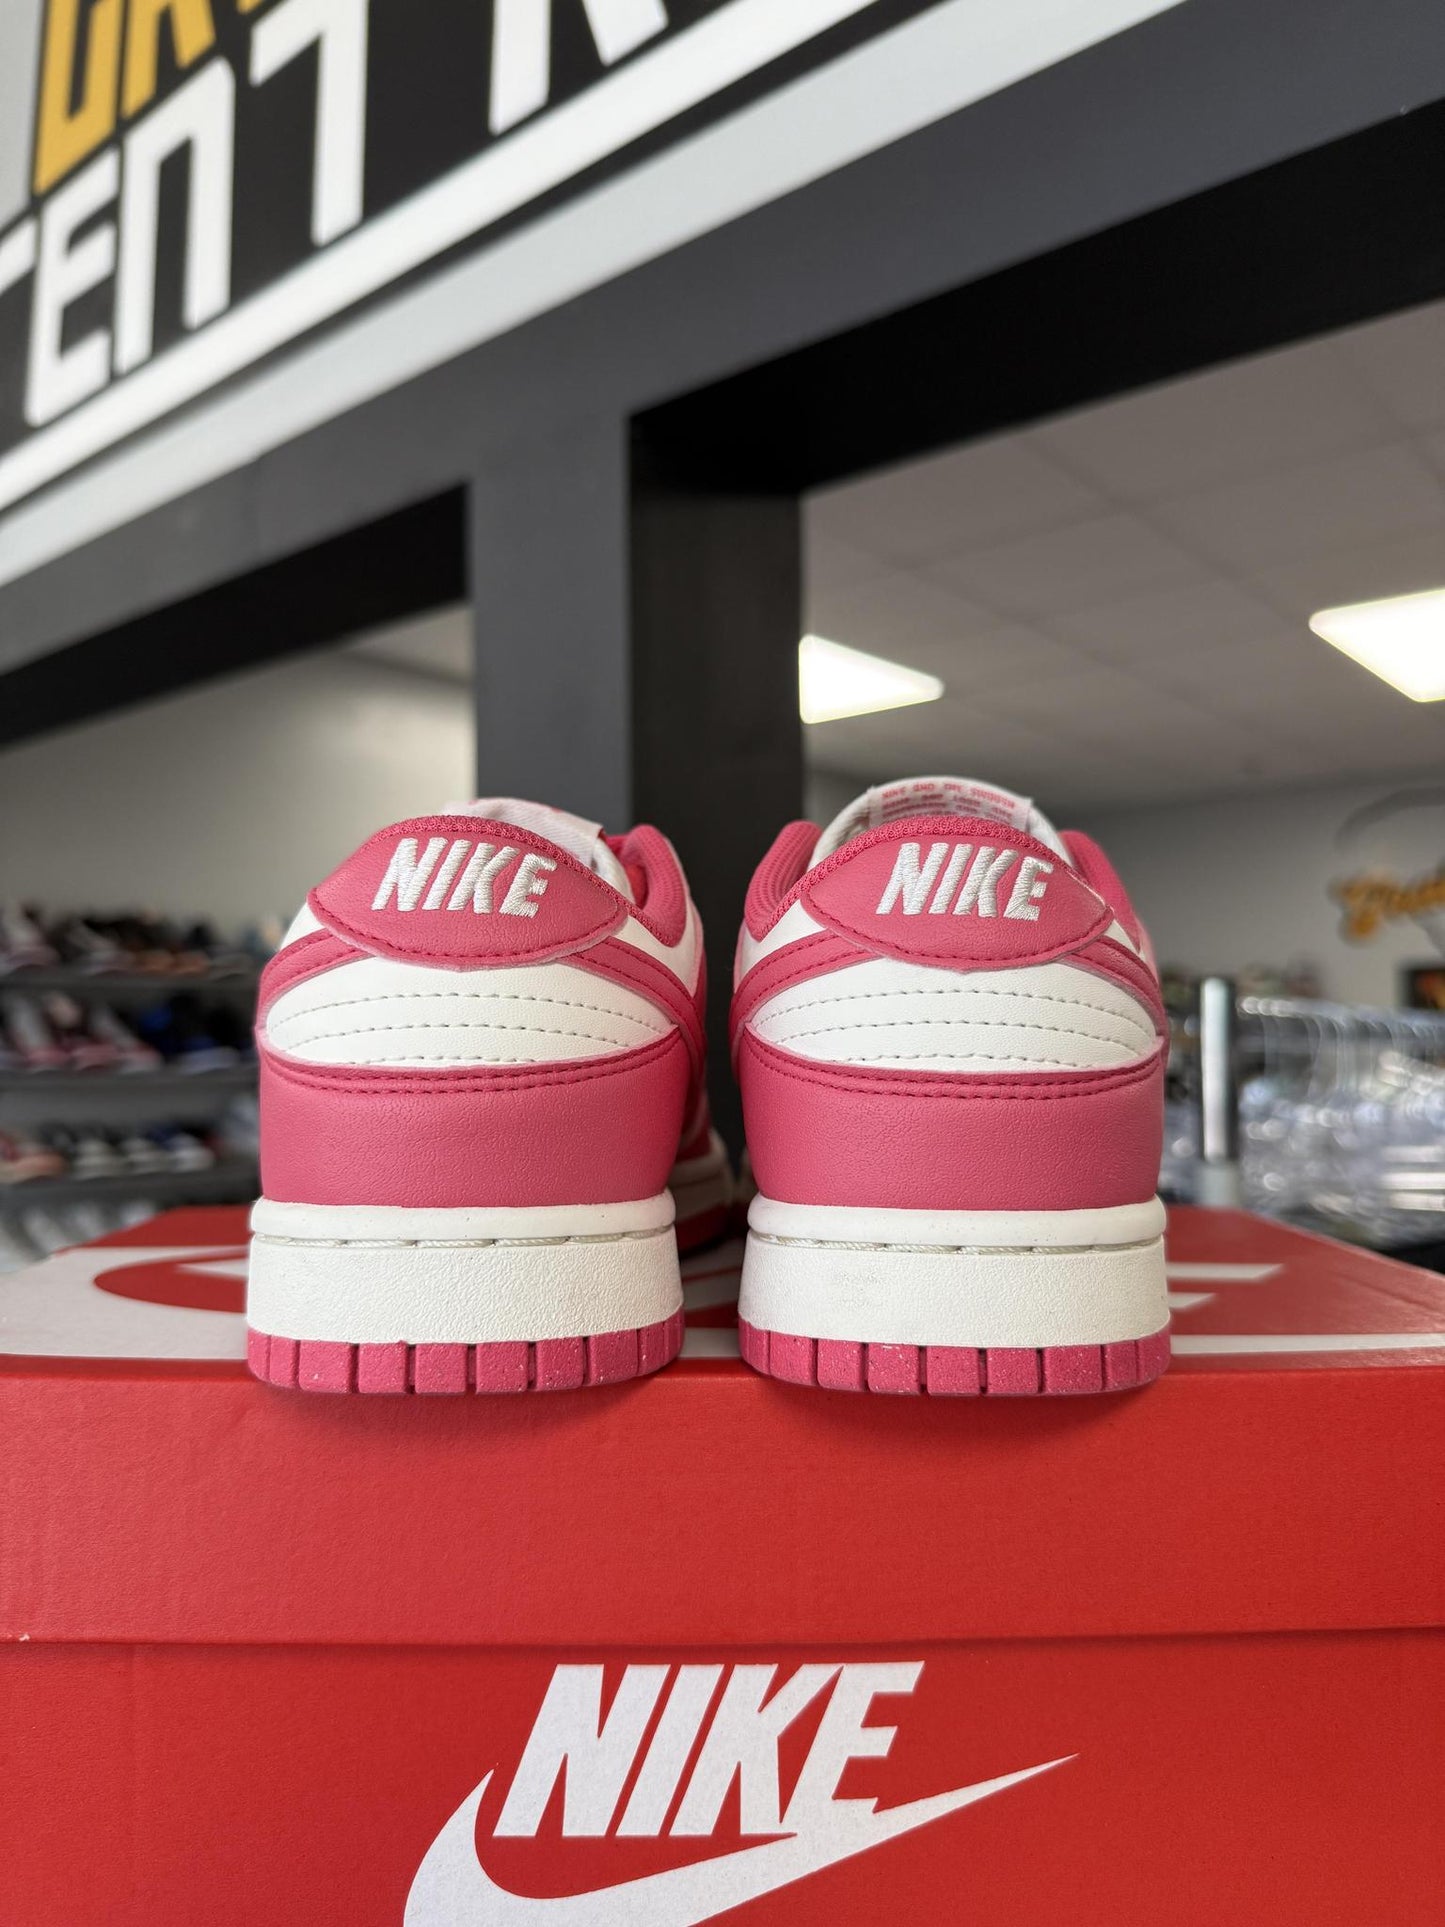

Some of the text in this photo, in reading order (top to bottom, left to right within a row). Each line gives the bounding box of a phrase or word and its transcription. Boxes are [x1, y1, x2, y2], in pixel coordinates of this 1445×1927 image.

[371, 837, 557, 918] NIKE
[875, 842, 1054, 921] NIKE
[492, 1661, 925, 1838] NIKE
